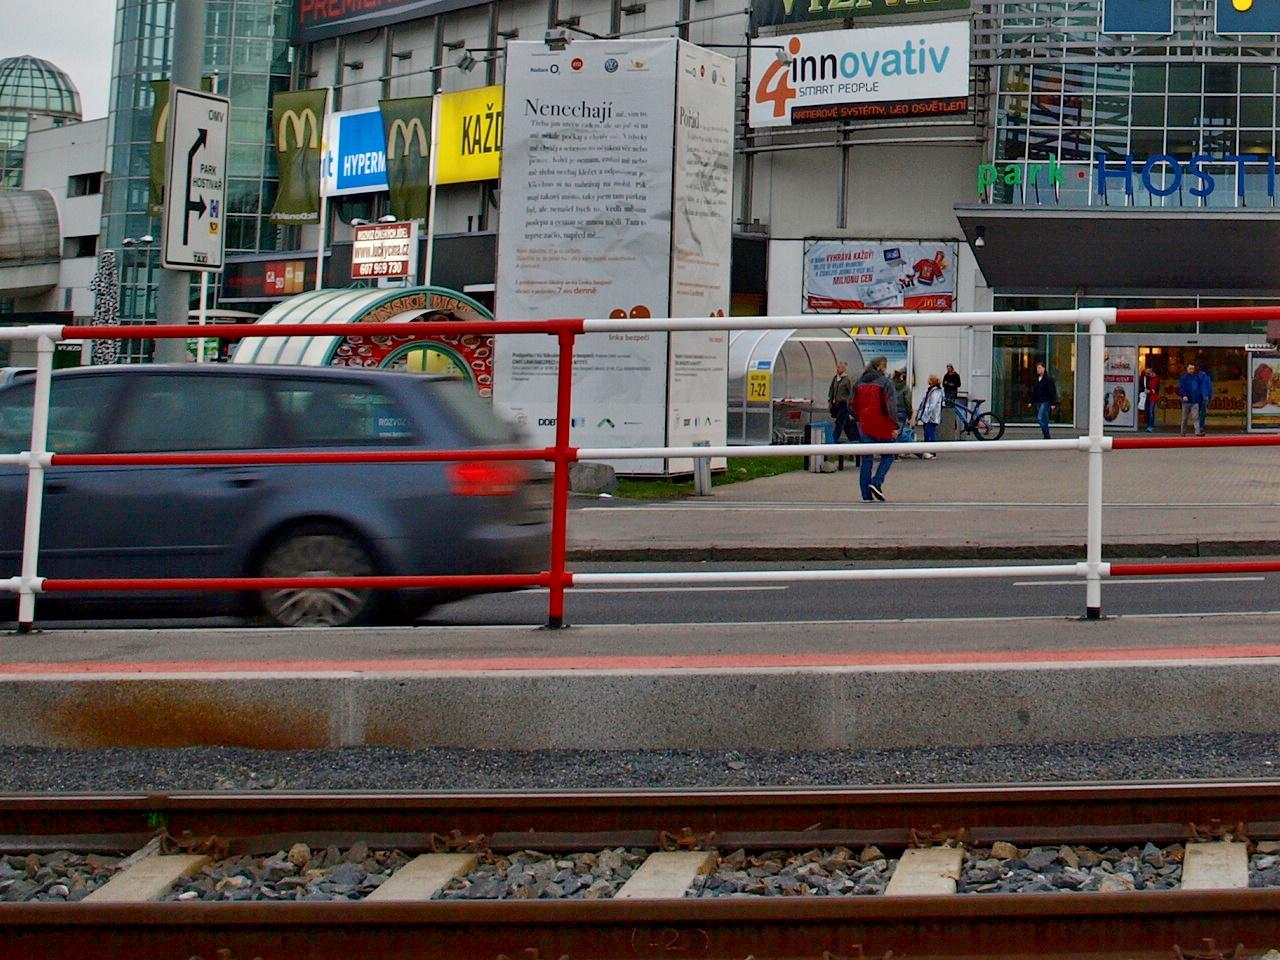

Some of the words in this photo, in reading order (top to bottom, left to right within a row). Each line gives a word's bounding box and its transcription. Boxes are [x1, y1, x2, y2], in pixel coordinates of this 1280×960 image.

[799, 84, 834, 98] SMART
[838, 82, 879, 94] PEOPLE
[525, 98, 613, 123] Nenechají
[200, 164, 217, 176] PARK
[977, 154, 1067, 194] park
[194, 253, 208, 263] TAXI
[360, 263, 373, 275] 607
[388, 261, 403, 273] 730
